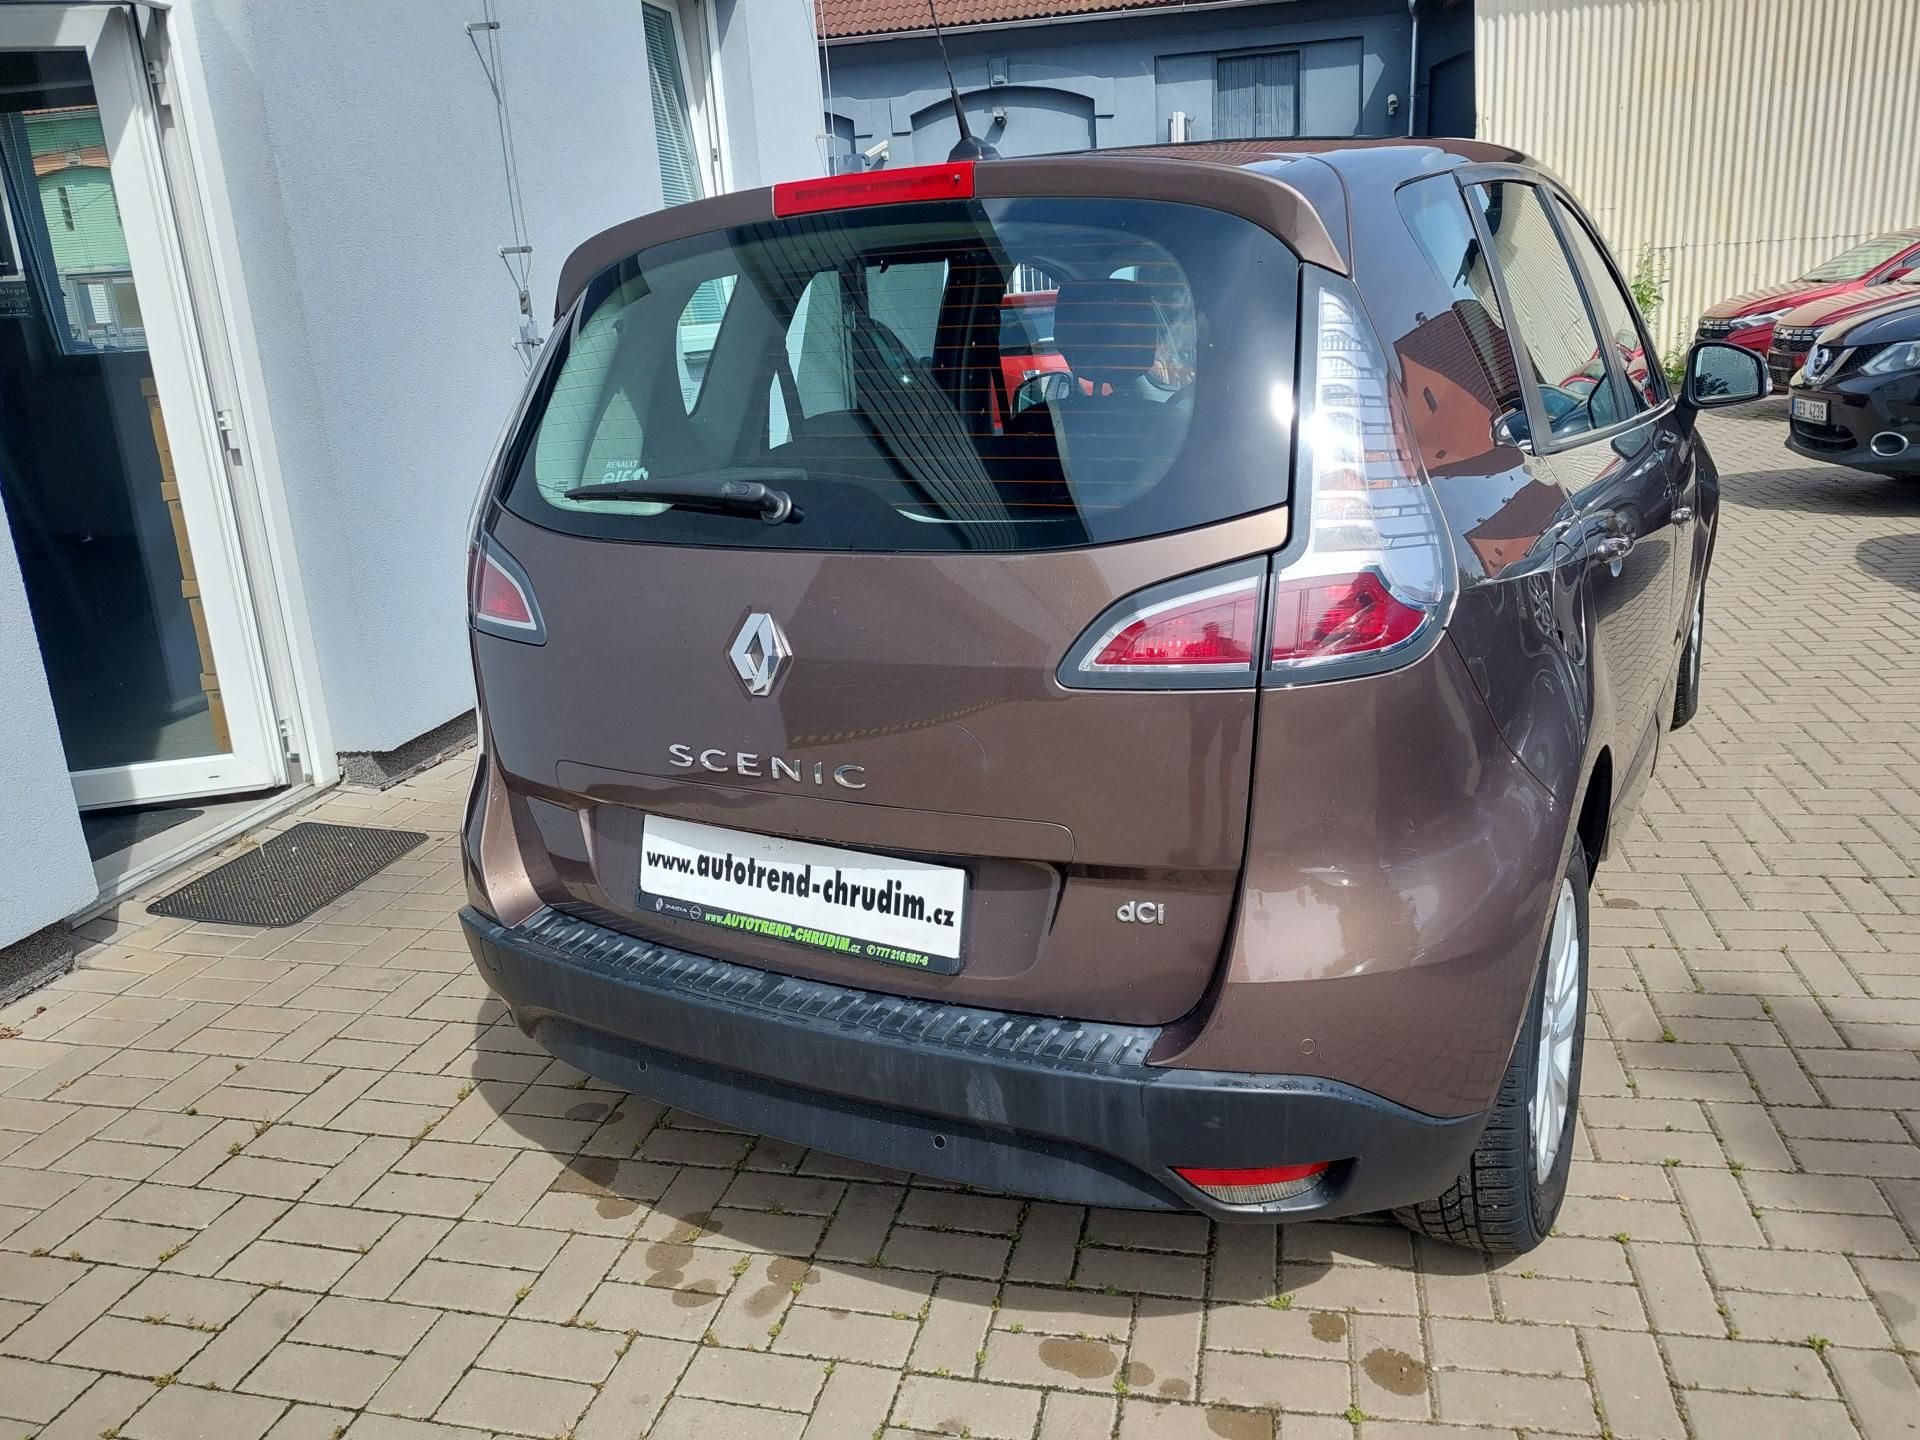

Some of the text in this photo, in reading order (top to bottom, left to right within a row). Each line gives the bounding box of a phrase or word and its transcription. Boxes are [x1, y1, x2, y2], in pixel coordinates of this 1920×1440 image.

[606, 460, 639, 468] RENAULT
[669, 743, 866, 789] SCENIC
[646, 850, 955, 927] www.autotrend-chrudim.cz
[705, 913, 862, 954] www.AUTOTREND-CHRUDIM.cz
